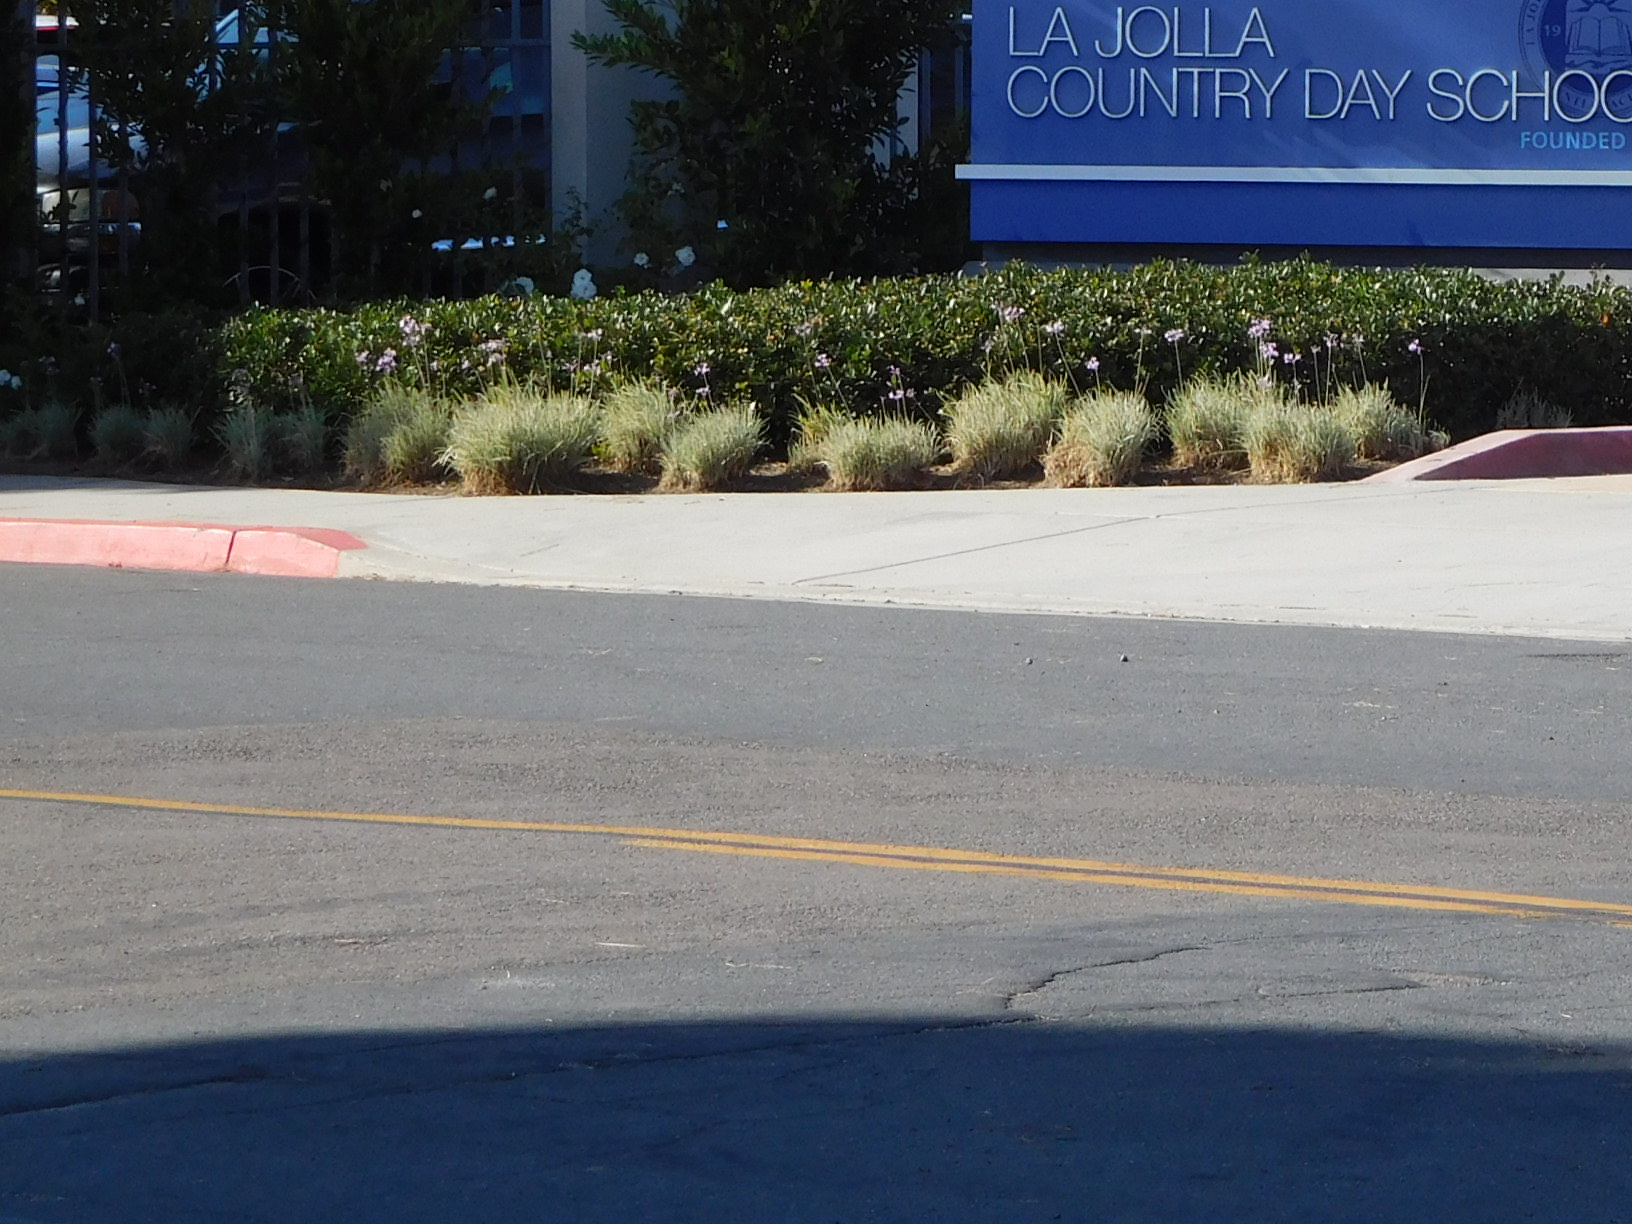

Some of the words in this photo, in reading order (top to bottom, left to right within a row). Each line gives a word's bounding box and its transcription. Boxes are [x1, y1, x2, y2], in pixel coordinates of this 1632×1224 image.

[1009, 6, 1079, 56] LA
[1094, 5, 1275, 58] JOLLA
[1545, 24, 1562, 37] 19
[1007, 65, 1289, 118] COUNTRY
[1304, 68, 1411, 120] DAY
[1520, 131, 1626, 150] FOUNDED
